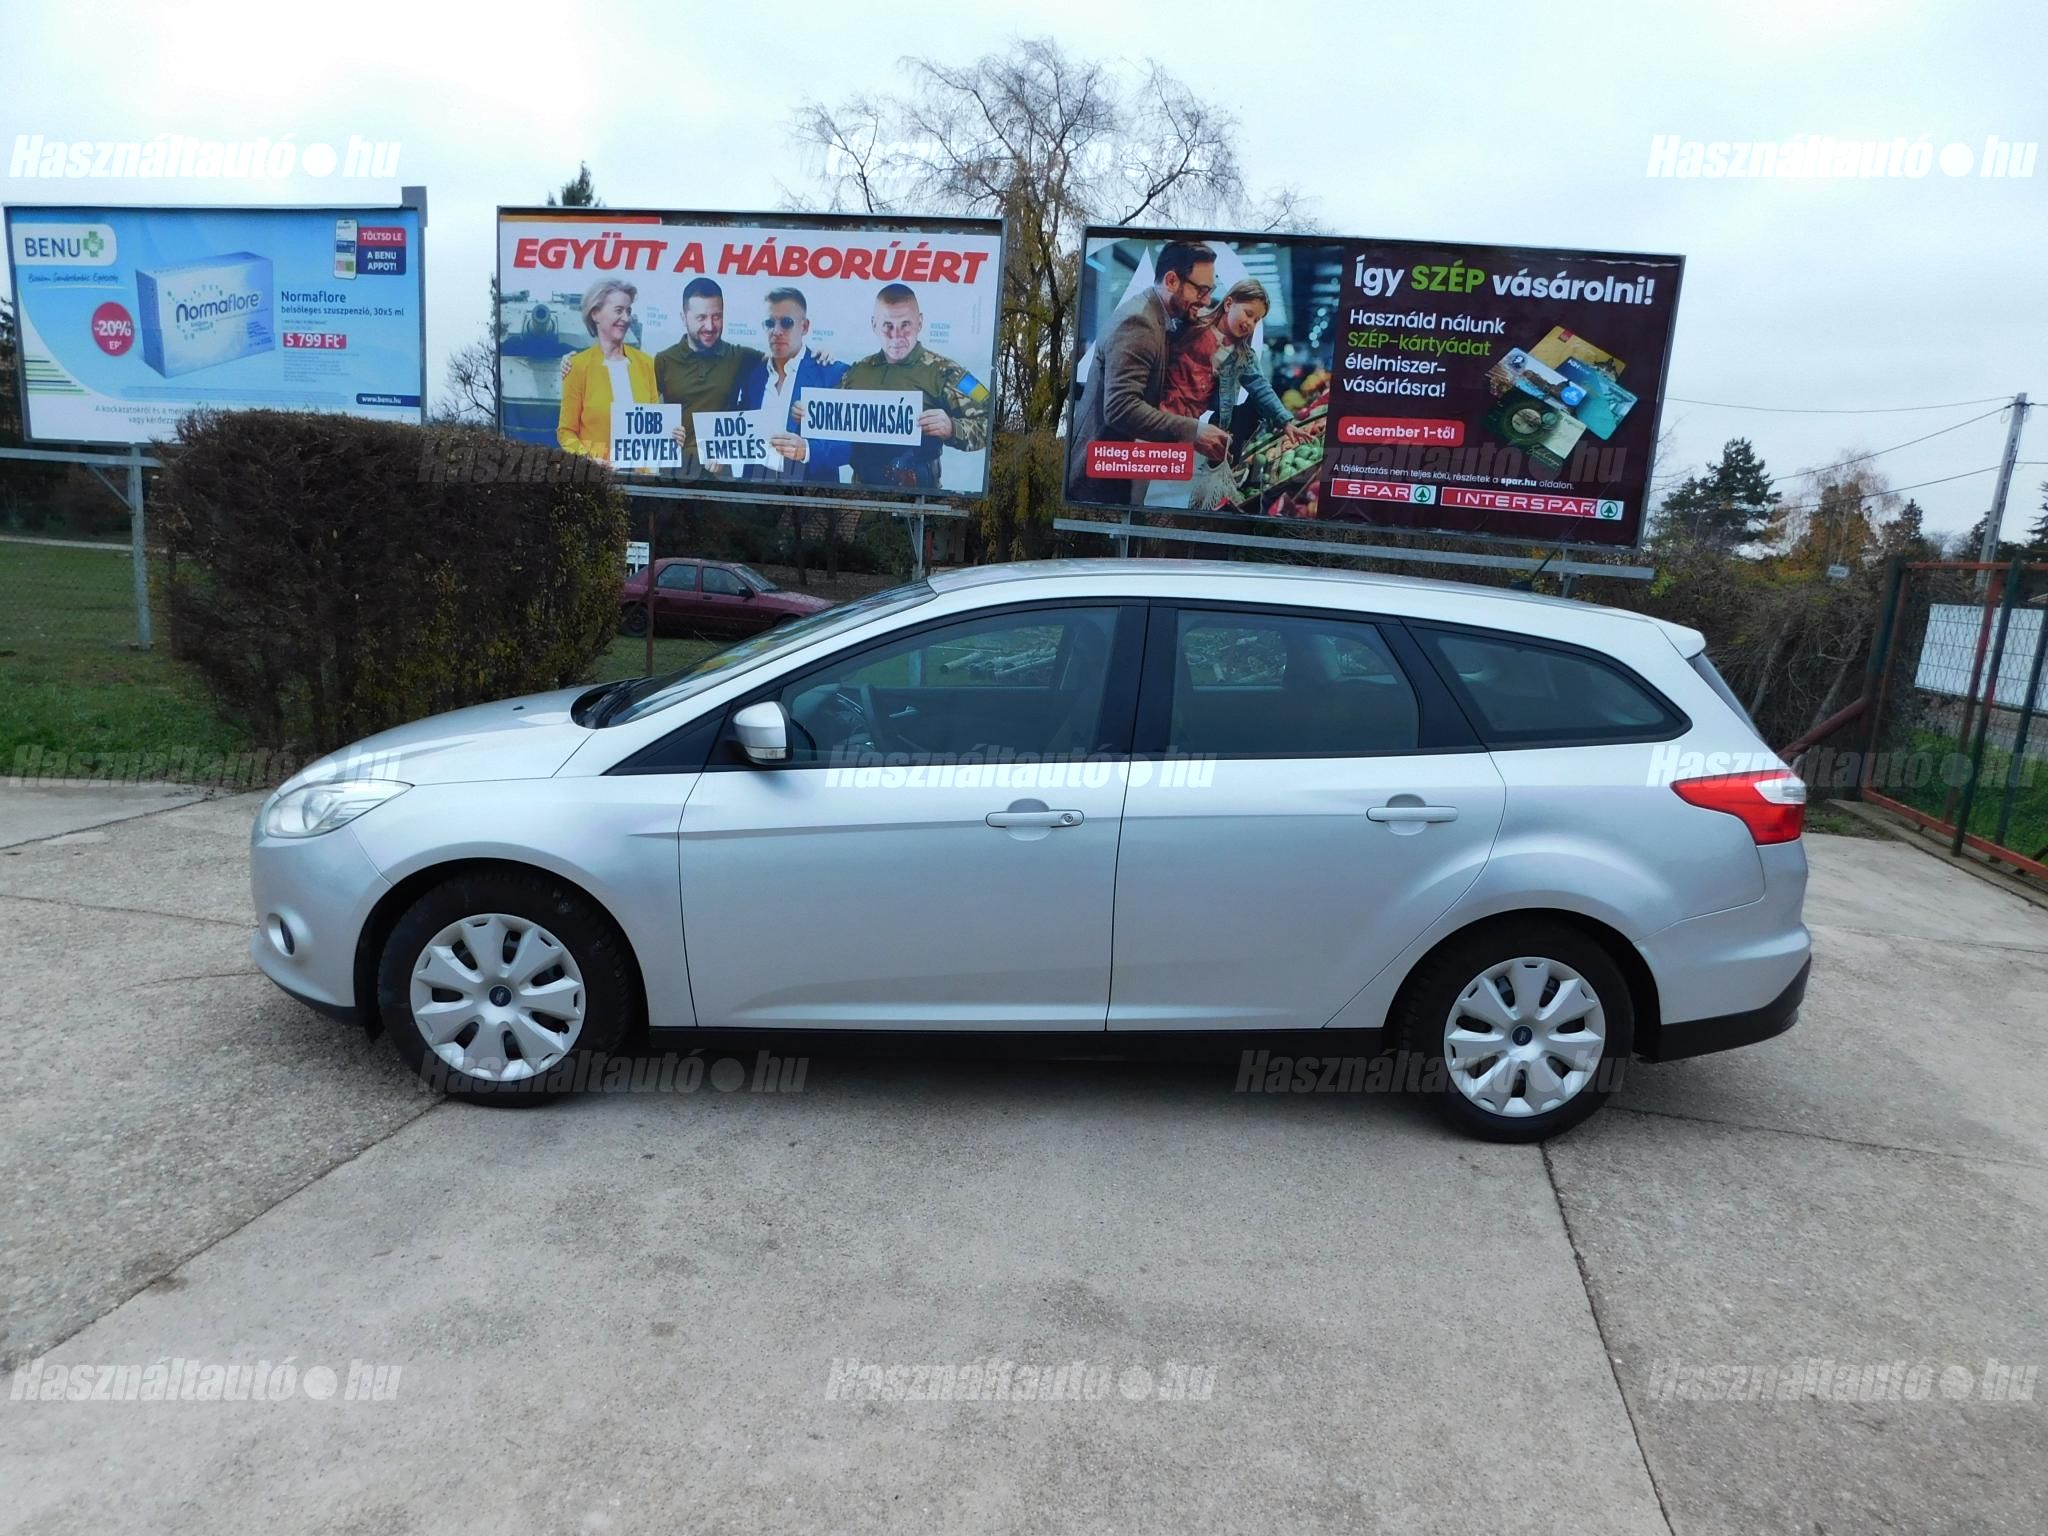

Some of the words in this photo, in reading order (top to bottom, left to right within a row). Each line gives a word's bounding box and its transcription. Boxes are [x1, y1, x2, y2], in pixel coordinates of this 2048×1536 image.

[362, 230, 392, 241] TÖLTSD
[392, 232, 403, 241] LE
[24, 237, 81, 258] BENU
[367, 251, 373, 259] A
[374, 251, 397, 260] BENU
[513, 232, 668, 270] EGYÜTT
[673, 242, 705, 274] A
[717, 236, 988, 284] HÁBORÚÉRT
[1354, 254, 1404, 296] Így
[1410, 259, 1486, 294] SZÉP
[1492, 268, 1655, 305] vásárolni!
[281, 290, 347, 303] Normaflore
[281, 305, 321, 316] belsőleges
[323, 307, 372, 317] szuszpenzió,
[374, 308, 393, 316] 30x5
[395, 307, 404, 316] ml
[1349, 309, 1437, 331] Használd
[1440, 313, 1506, 335] nálunk
[286, 333, 294, 347] 5
[299, 333, 322, 347] 799
[1347, 329, 1491, 357] SZÉP-kártyádat
[1344, 353, 1446, 375] élelmiszer-
[1343, 376, 1446, 398] vásárlásra!
[625, 406, 663, 435] TÖBB
[714, 412, 754, 437] ADÓ-
[807, 397, 914, 435] SORKATONASÁG
[1346, 423, 1421, 439] december
[1423, 425, 1455, 440] 1-től
[614, 438, 679, 461] FEGYVER
[705, 434, 767, 460] EMELÉS
[1094, 446, 1129, 460] Hideg
[1131, 446, 1146, 458] és
[1148, 448, 1187, 462] meleg
[1094, 460, 1168, 473] élelmiszerre
[1170, 462, 1185, 474] is!
[1340, 464, 1389, 476] tájékoztatás
[1389, 469, 1409, 477] nem
[1410, 469, 1431, 480] teljes
[1452, 471, 1491, 483] részletek
[1492, 475, 1499, 484] a
[1500, 475, 1537, 488] spar.hu
[1538, 478, 1574, 490] oldalon.
[1347, 483, 1410, 499] SPAR
[1457, 491, 1596, 516] INTERSPAR
